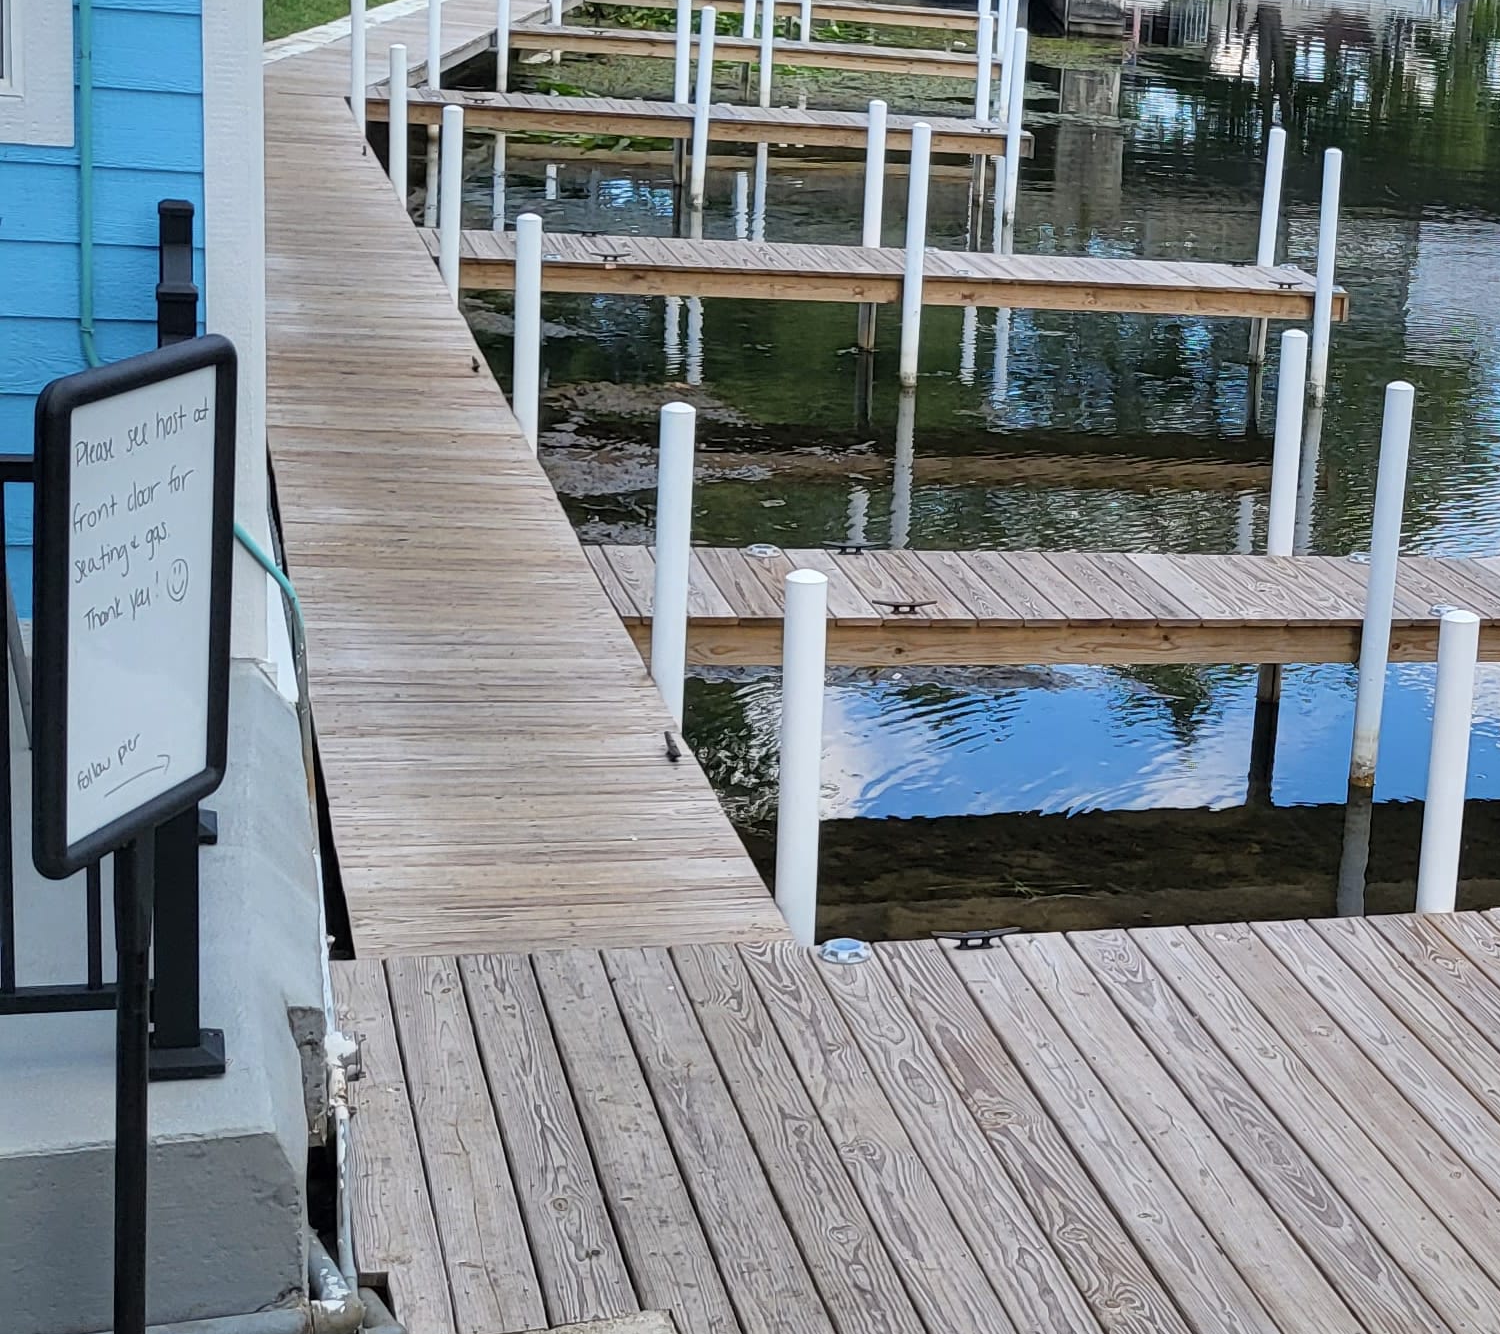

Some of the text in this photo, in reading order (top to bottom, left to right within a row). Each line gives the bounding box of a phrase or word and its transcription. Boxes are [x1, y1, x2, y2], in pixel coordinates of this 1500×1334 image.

[75, 397, 209, 467] Please see host at
[73, 465, 194, 534] front door for
[75, 544, 130, 583] seating
[83, 596, 123, 631] Thank
[118, 733, 141, 766] pier
